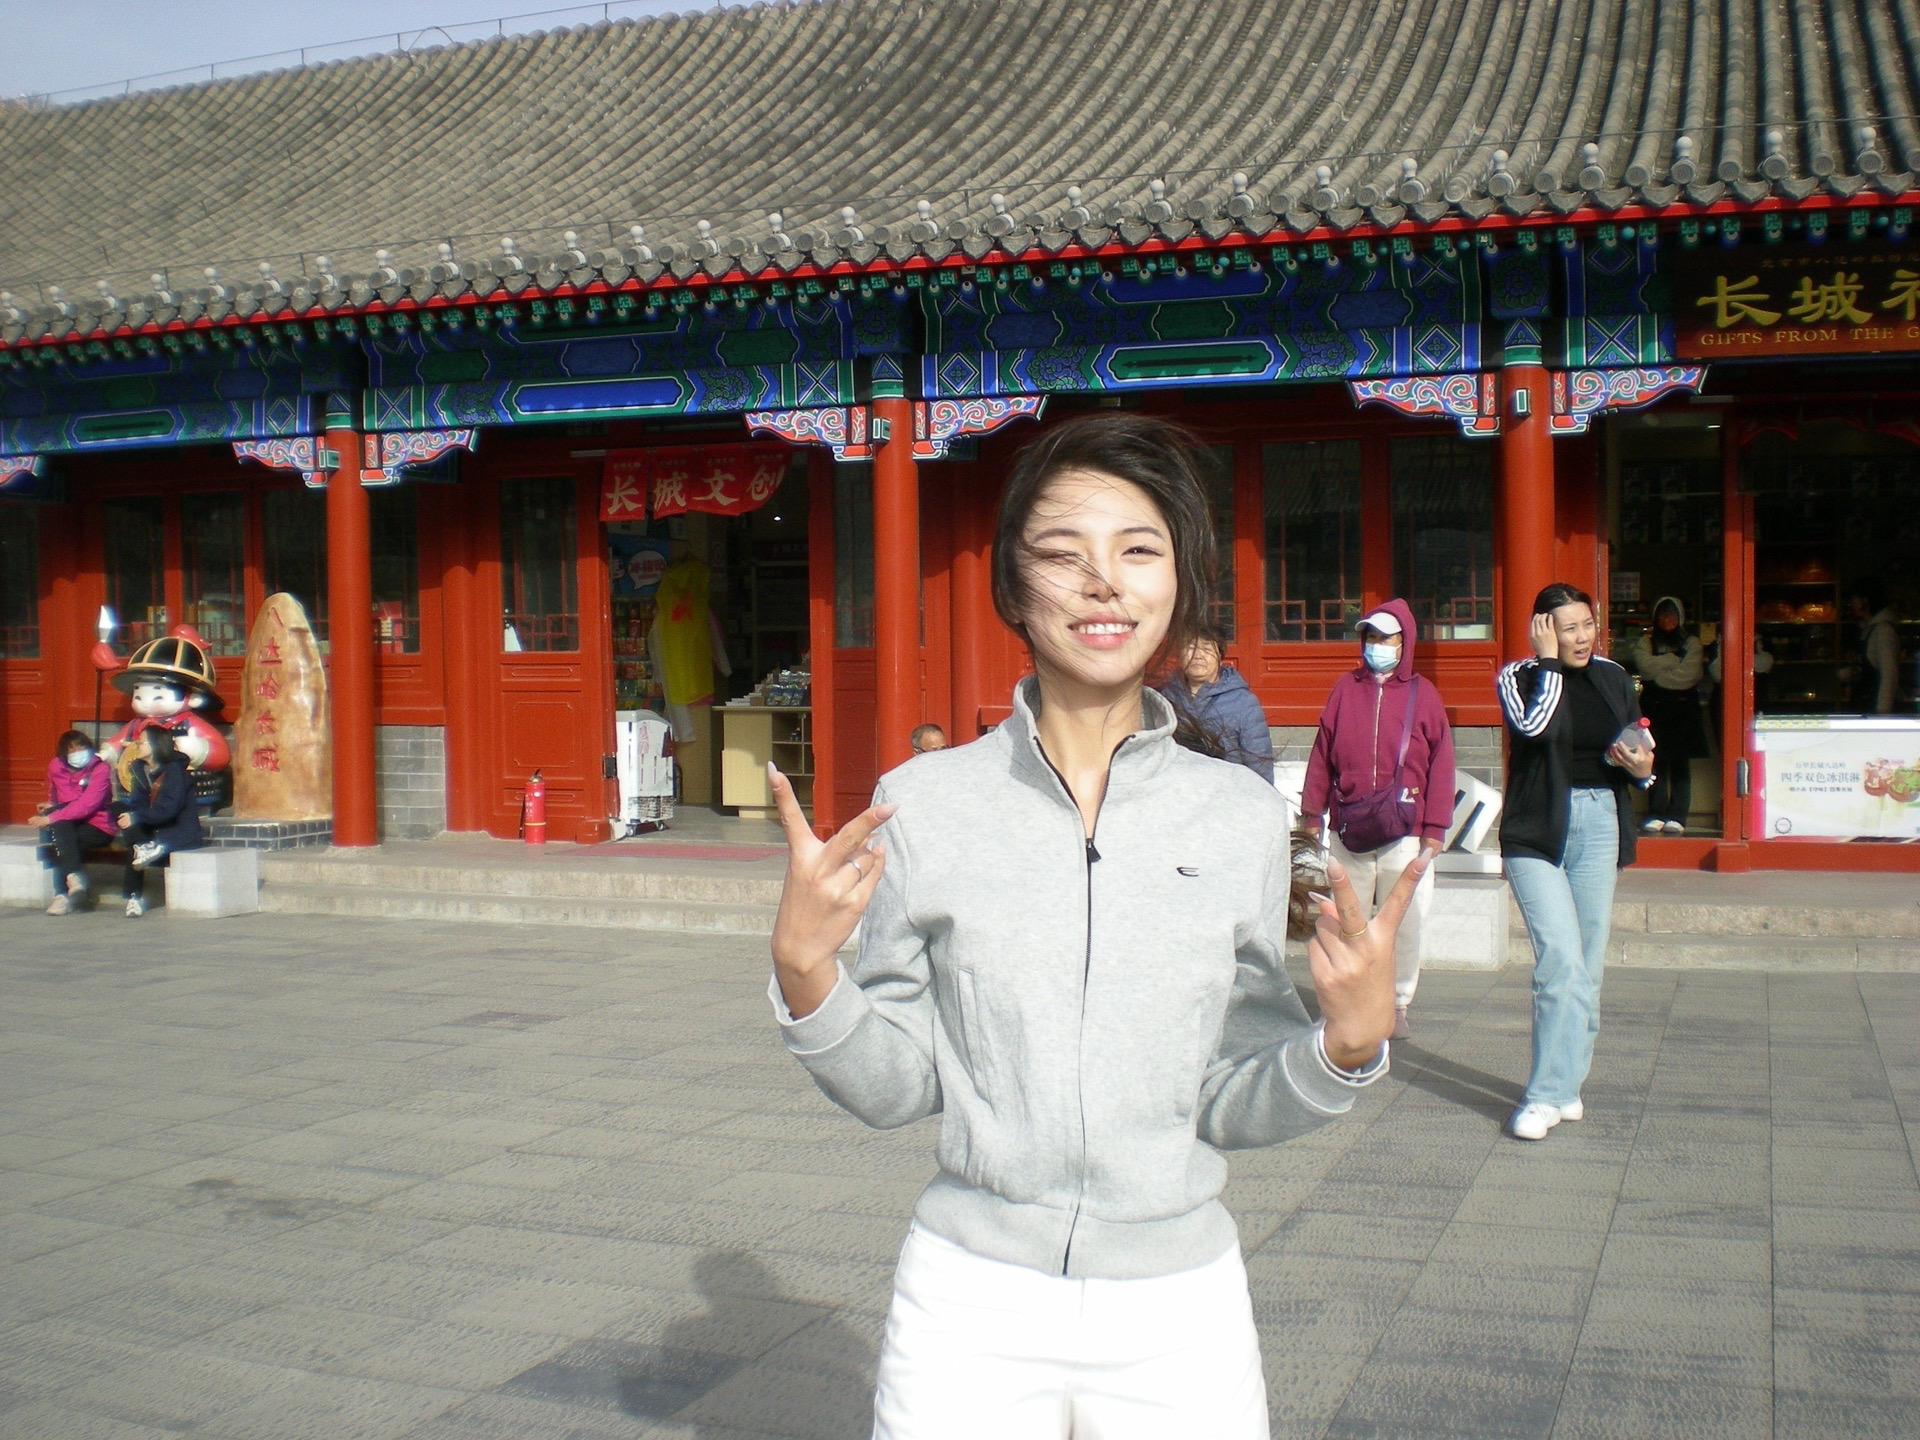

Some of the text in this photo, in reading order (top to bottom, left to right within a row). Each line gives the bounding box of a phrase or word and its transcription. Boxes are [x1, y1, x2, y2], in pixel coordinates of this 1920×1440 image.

[1701, 331, 1763, 346] GIFTS
[1775, 328, 1839, 344] FROM
[1850, 327, 1895, 341] THE
[606, 465, 785, 515] 长城文创
[252, 607, 284, 772] 八达岭长城
[1781, 772, 1860, 783] 四季双色冰淇淋
